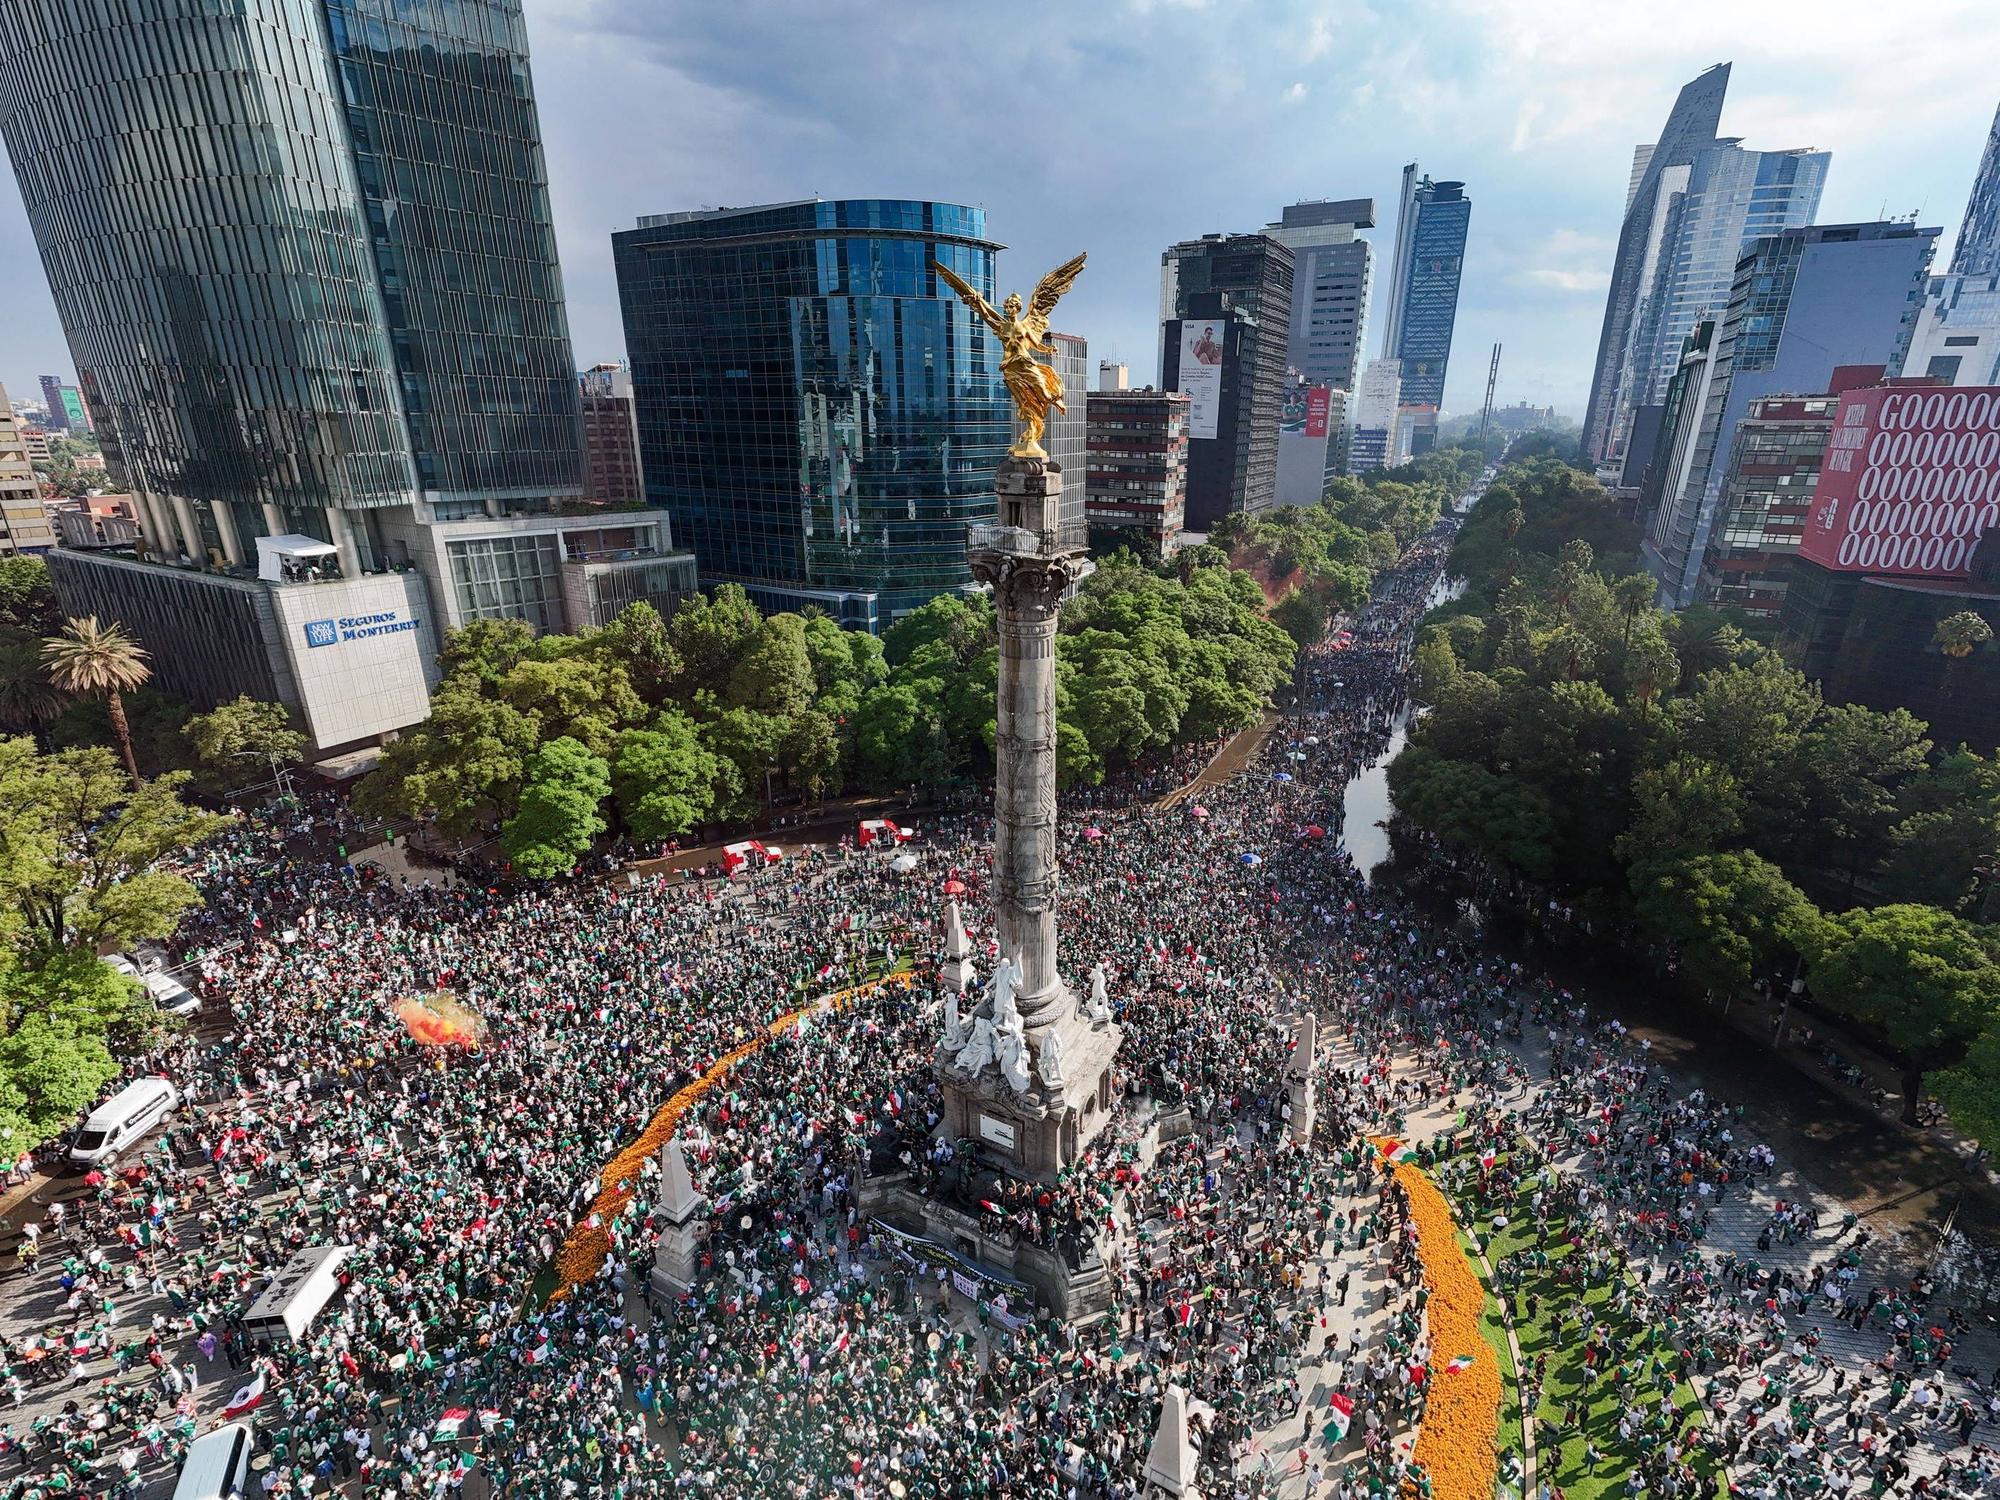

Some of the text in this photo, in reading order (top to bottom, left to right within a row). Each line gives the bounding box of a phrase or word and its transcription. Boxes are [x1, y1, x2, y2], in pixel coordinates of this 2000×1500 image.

[338, 611, 396, 629] SEGUROS
[311, 623, 331, 631] NEW
[341, 619, 420, 641] MONTERREY
[310, 628, 335, 637] YORK
[315, 634, 334, 643] LIFE
